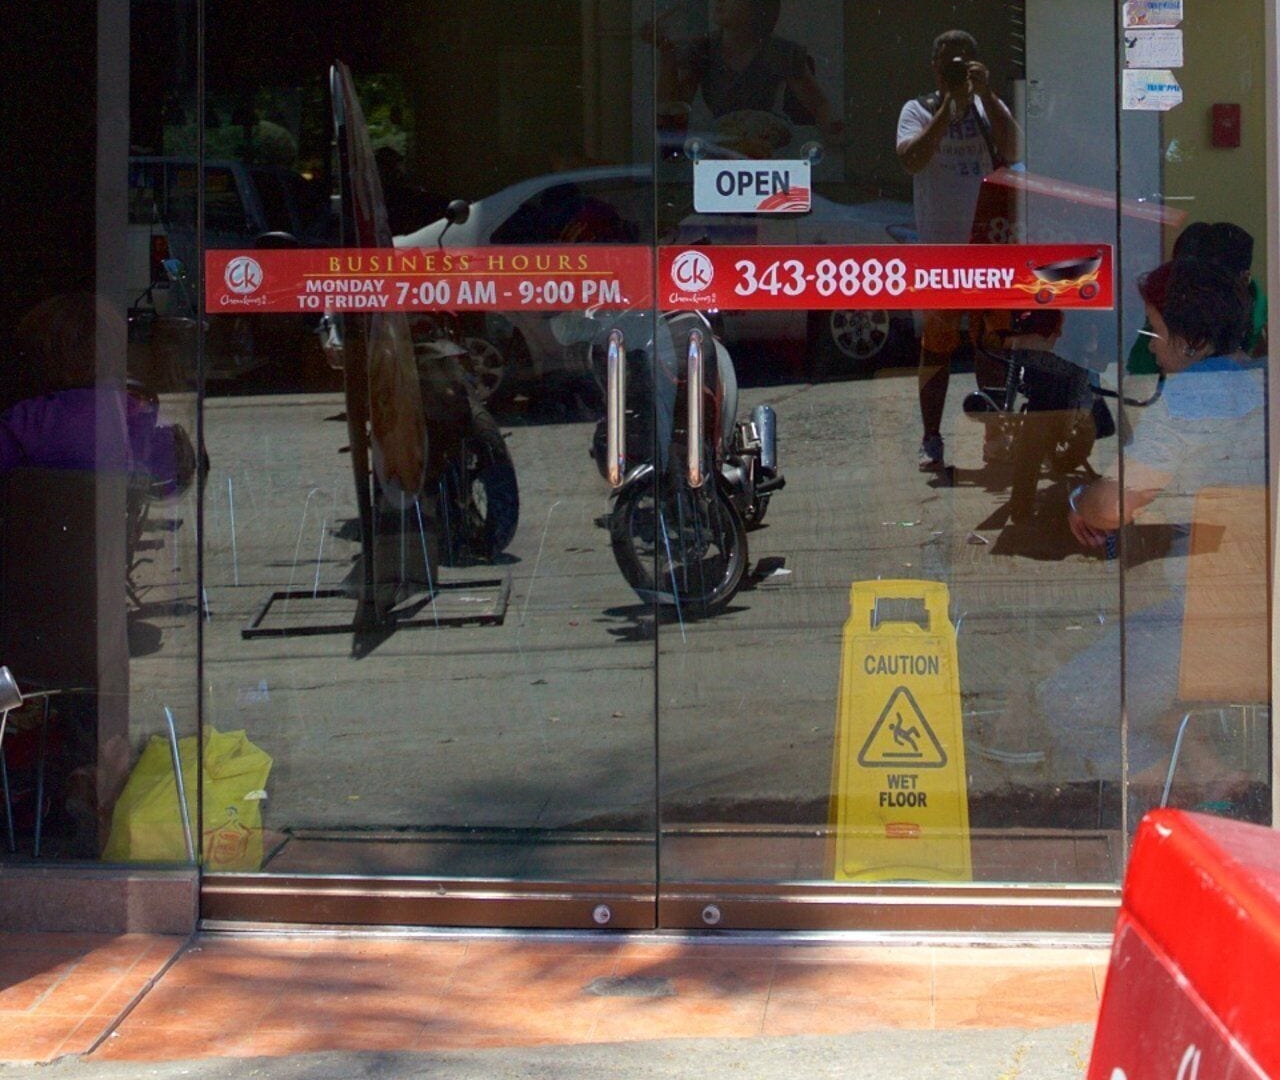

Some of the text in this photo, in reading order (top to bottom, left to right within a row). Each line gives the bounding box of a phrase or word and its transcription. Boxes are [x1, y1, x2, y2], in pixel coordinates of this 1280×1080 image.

[716, 170, 790, 197] OPEN
[329, 254, 588, 271] BUSINESS HOURS
[306, 279, 385, 293] MONDAY
[734, 258, 1015, 297] 343-8888 DELIVERY
[297, 294, 389, 308] TO FRIDAY
[396, 280, 451, 305] 7:00
[457, 280, 497, 305] AM
[519, 280, 575, 304] 9:00
[864, 655, 939, 675] CAUTION
[887, 774, 918, 789] WET
[879, 792, 927, 808] FLOOR
